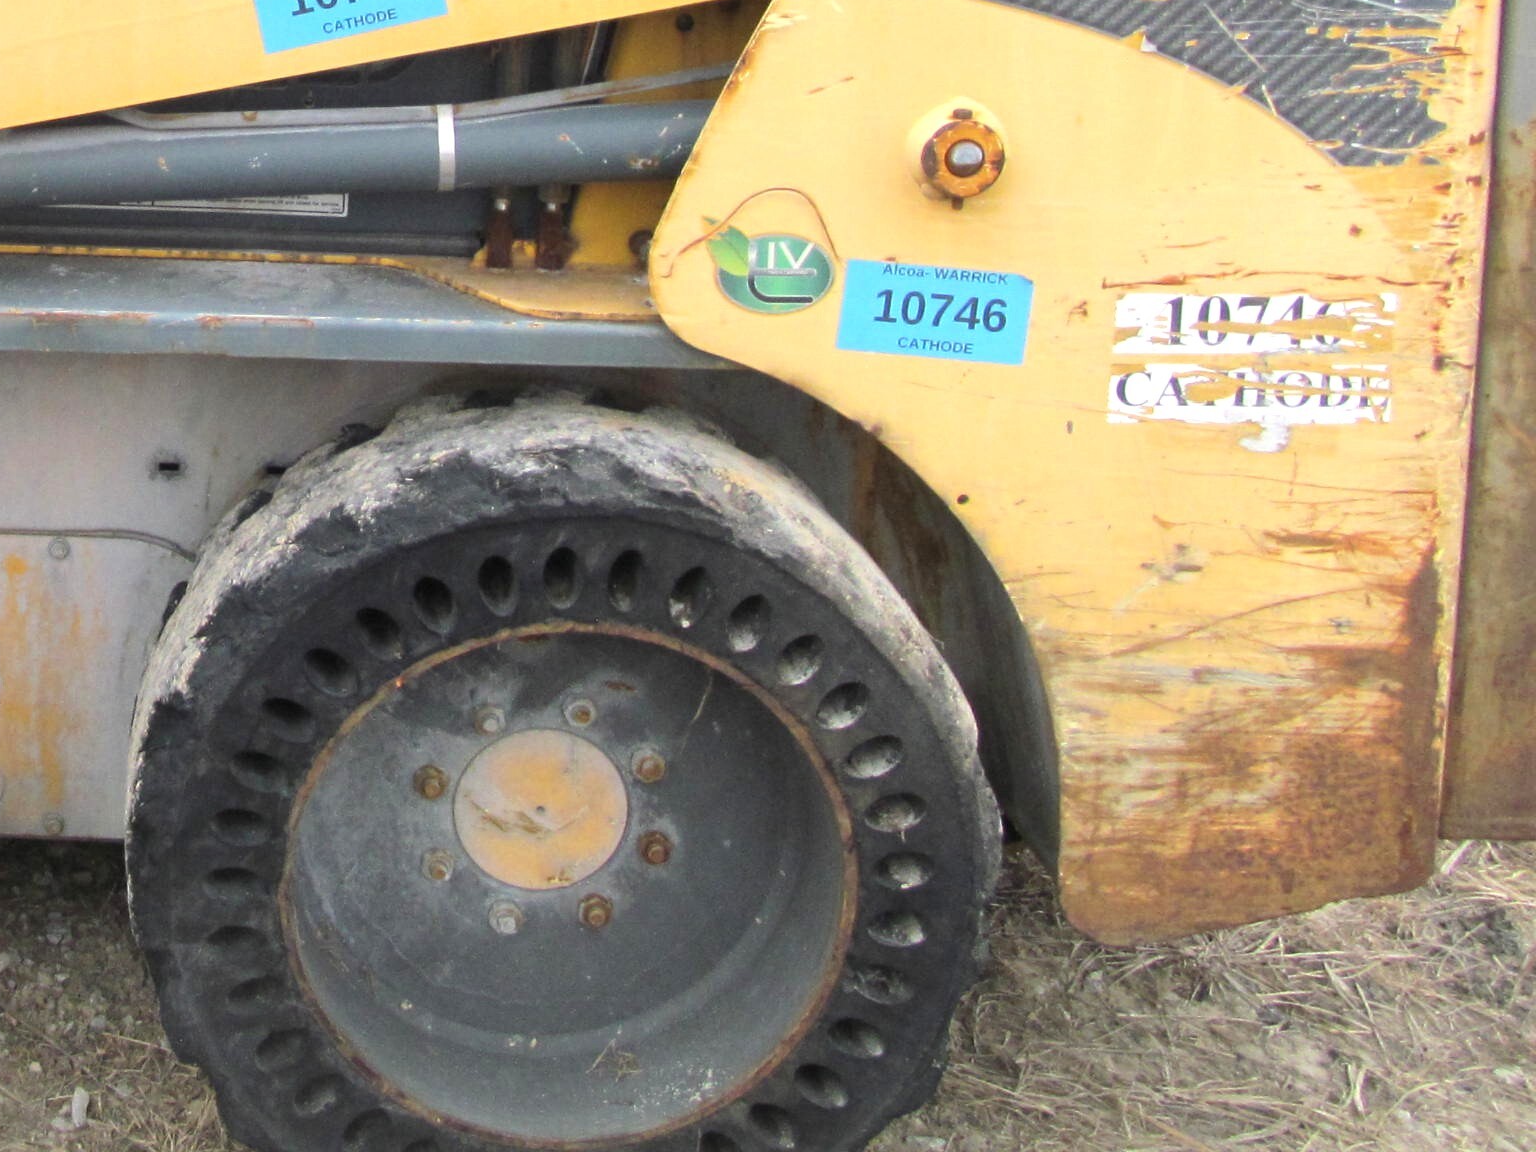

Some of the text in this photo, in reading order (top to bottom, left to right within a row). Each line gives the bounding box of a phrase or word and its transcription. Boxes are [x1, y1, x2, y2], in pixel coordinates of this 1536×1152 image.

[323, 8, 398, 34] CATHODE
[882, 263, 1009, 285] Alcoa- WARRICK
[873, 289, 1008, 333] 10746
[897, 336, 974, 355] CATHODE
